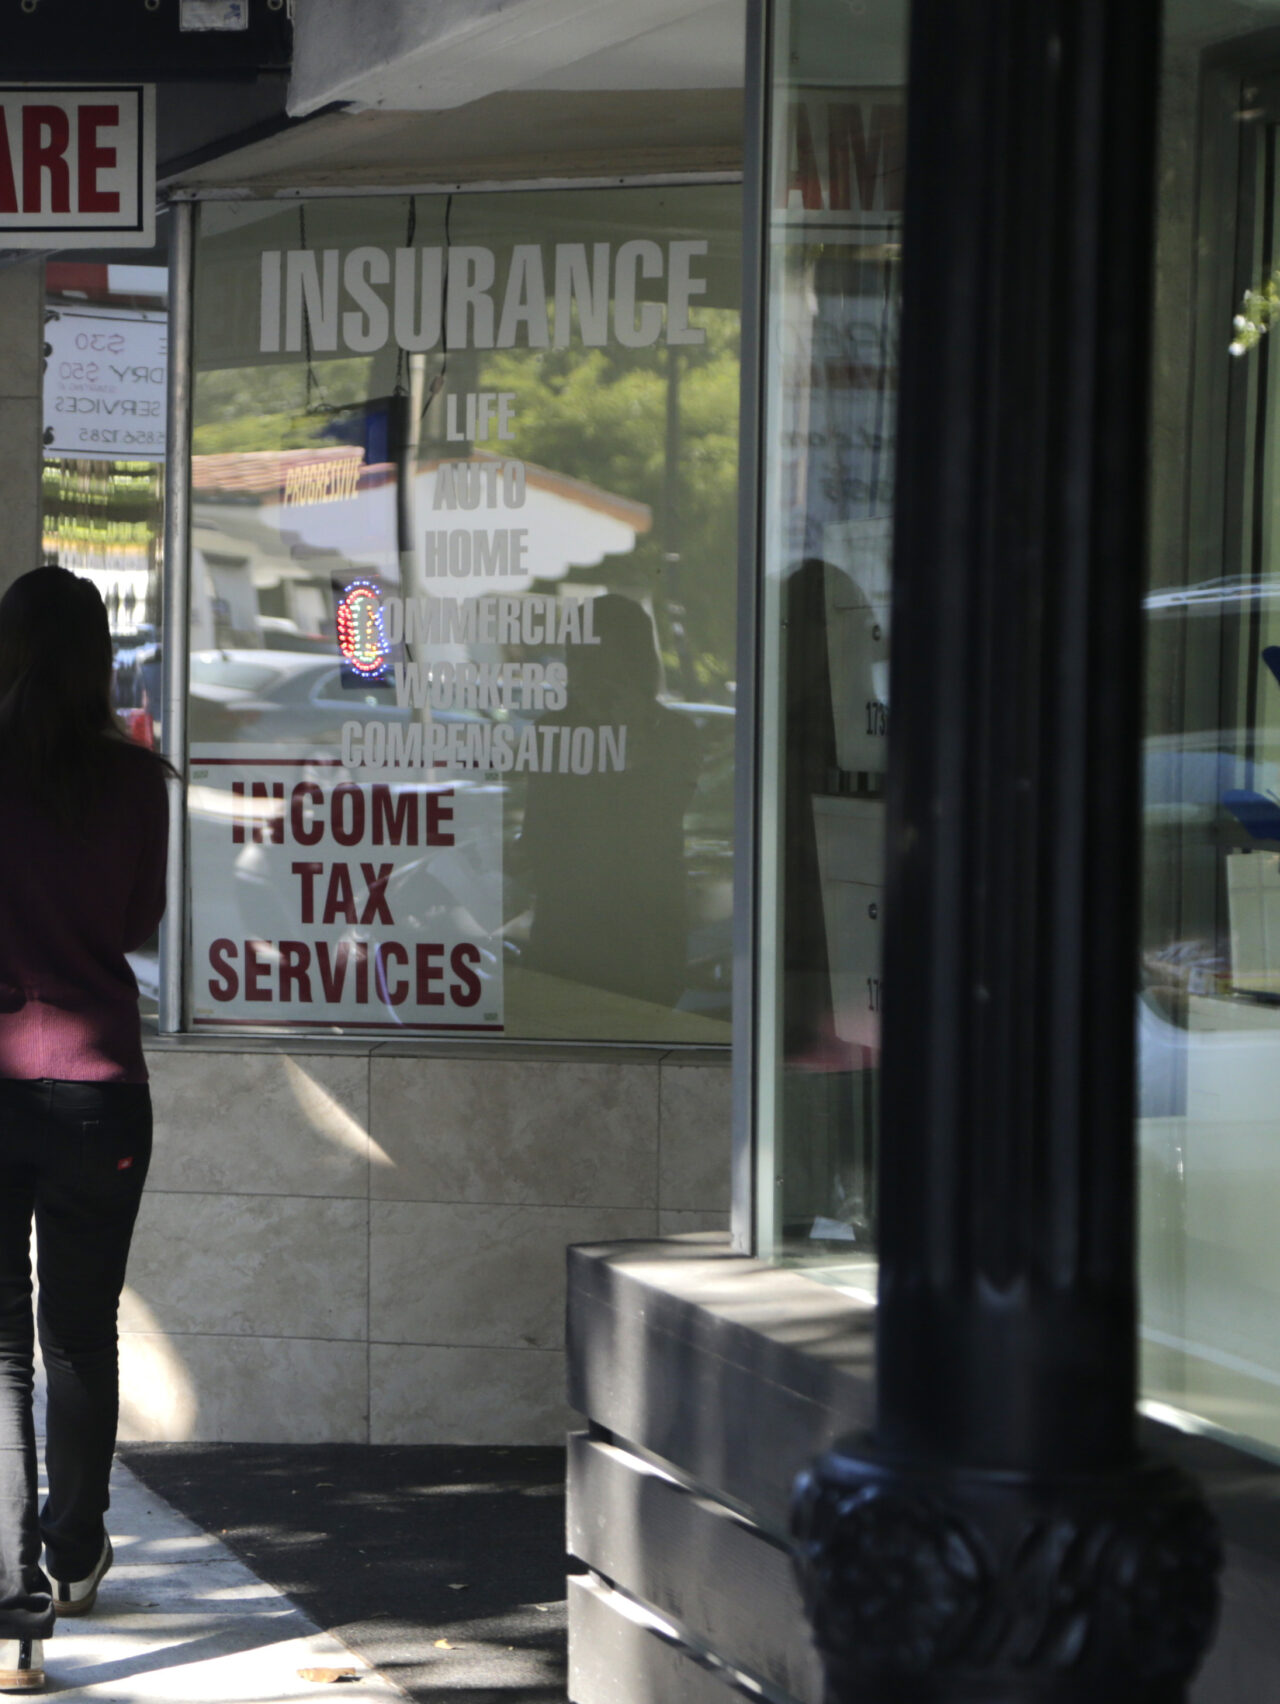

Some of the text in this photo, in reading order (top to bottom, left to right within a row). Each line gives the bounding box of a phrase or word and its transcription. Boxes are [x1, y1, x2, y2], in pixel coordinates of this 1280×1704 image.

[259, 240, 708, 352] INSURANCE
[447, 392, 516, 442] LIFE
[284, 457, 362, 508] PROGRESSIVE
[431, 461, 527, 512] AUTO
[425, 527, 529, 578] HOME
[395, 661, 568, 711] WORKERS
[342, 718, 627, 775] COMPENSATION
[232, 781, 455, 846] INCOME
[292, 862, 395, 925] TAX
[208, 938, 482, 1008] SERVICES
